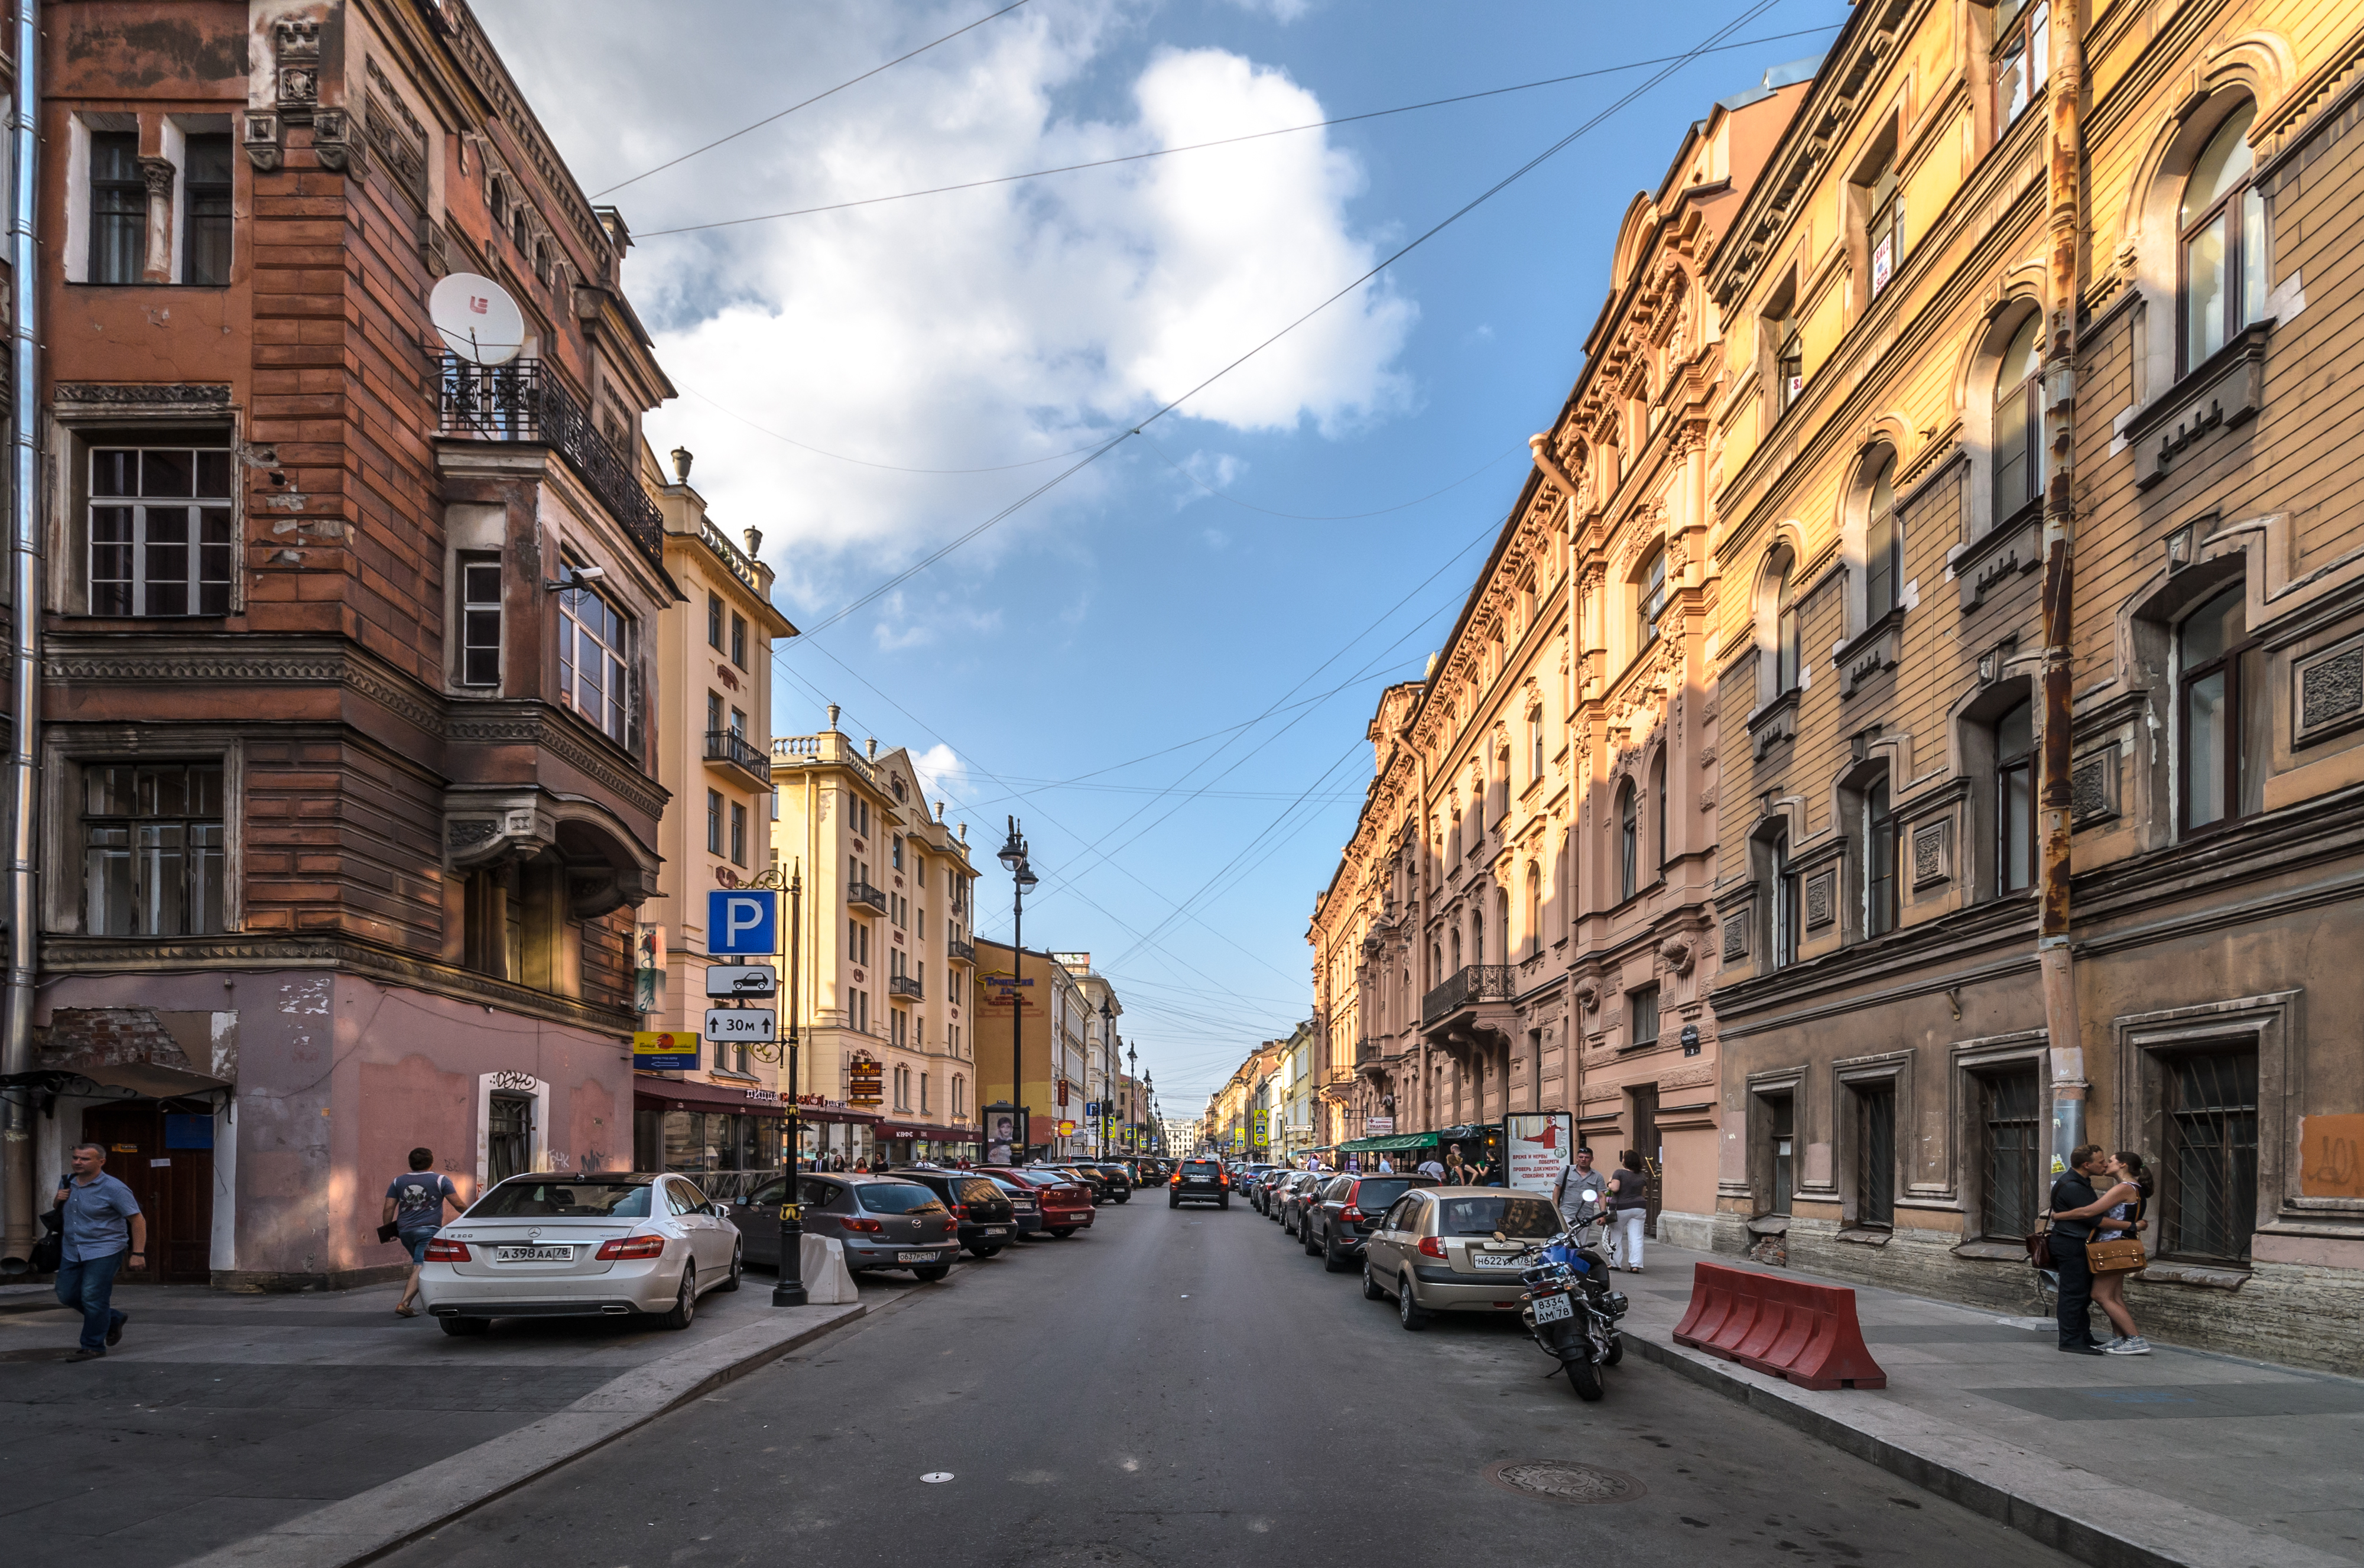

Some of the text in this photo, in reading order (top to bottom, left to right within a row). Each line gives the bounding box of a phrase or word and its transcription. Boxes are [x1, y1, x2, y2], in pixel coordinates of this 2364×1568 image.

[1876, 236, 1889, 264] SALE
[727, 898, 763, 947] P
[726, 1019, 755, 1031] 30м
[1538, 1297, 1564, 1309] 8334
[1556, 1308, 1570, 1317] 78
